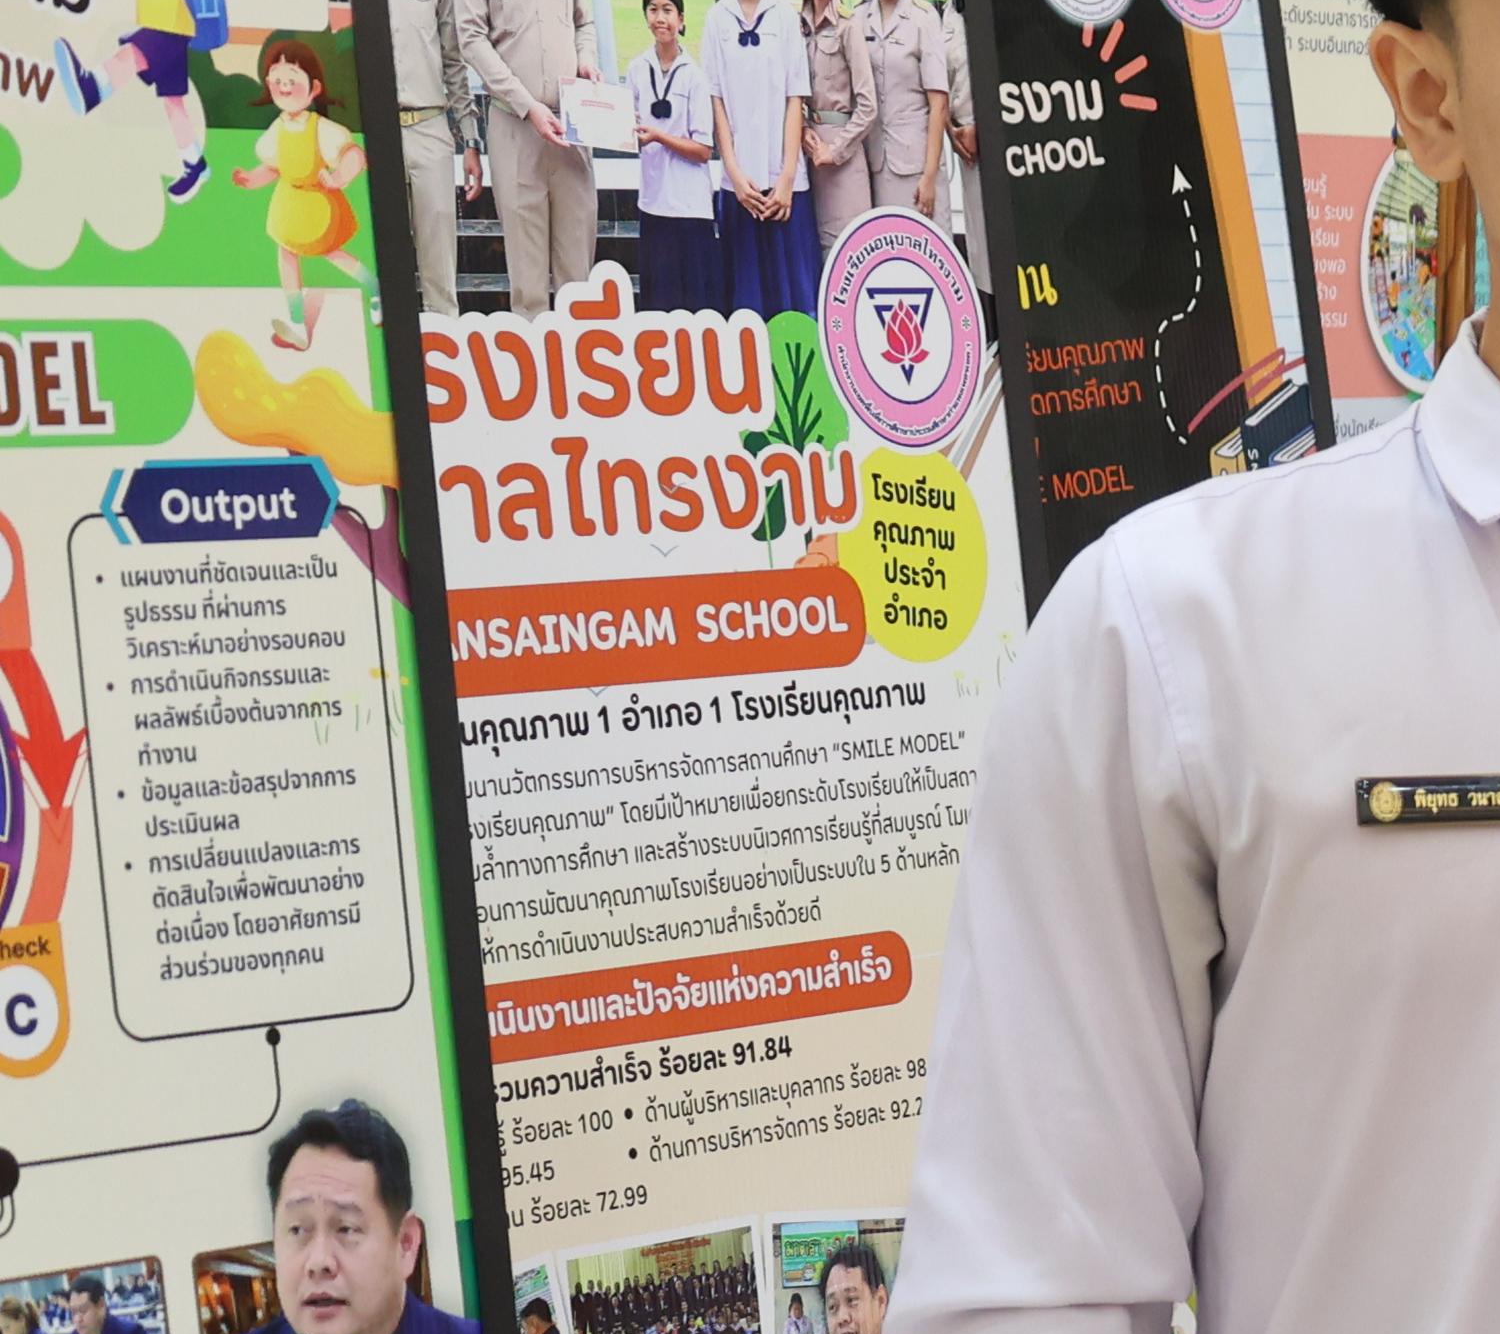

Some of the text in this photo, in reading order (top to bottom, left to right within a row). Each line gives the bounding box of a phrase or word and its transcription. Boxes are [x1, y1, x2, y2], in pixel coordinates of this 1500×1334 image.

[1004, 135, 1106, 179] CHOOL
[870, 473, 956, 514] โรงเรียน
[1053, 466, 1135, 503] MODEL
[160, 486, 297, 531] Output
[872, 519, 956, 558] คุณภาพ
[120, 554, 338, 587] แผนงานที่ชัดเจนและเป็น
[883, 559, 947, 593] ประจำ
[123, 589, 286, 631] รูปธรรม ที่ผ่านการ
[450, 595, 849, 664] NSAINGAM SCHOOL
[883, 598, 949, 633] อำเภอ
[127, 627, 346, 662] วิเคราะห์มาอย่างรอบคอบ
[130, 664, 331, 696] การดำเนินกิจกรรมและ
[134, 694, 343, 730] ผลลัพธ์เบื้องต้นจากการ
[598, 706, 611, 733] 1
[621, 695, 702, 733] อำเภอ
[709, 700, 722, 725] 1
[734, 679, 927, 726] โรงเรียนคุณภาพ
[138, 740, 198, 767] ทำงาน
[141, 766, 357, 809] ข้อมูลและข้อสรุปจากการ
[145, 811, 241, 840] ประเมินผล
[149, 835, 361, 874] การเปลี่ยนแปลงและการ
[880, 853, 891, 874] 5
[896, 845, 961, 873] ด้านหลัก
[152, 868, 365, 910] ตัดสินใจเพื่อพัฒนาอย่าง
[156, 904, 361, 946] ต่อเนื่อง โดยอาศัยการมี
[160, 945, 325, 982] ส่วนร่วมของทุกคน
[5, 994, 39, 1036] C
[658, 1044, 727, 1080] ร้อยละ
[732, 1035, 793, 1067] 91.84
[644, 1069, 846, 1129] ด้านผู้บริหารและบุคลากร
[850, 1060, 903, 1089] ร้อยละ
[512, 1109, 614, 1147] ร้อยละ 100
[649, 1112, 829, 1165] ด้านการบริหารจัดการ
[833, 1101, 886, 1132] ร้อยละ
[530, 1184, 648, 1227] ร้อยละ 72.99
